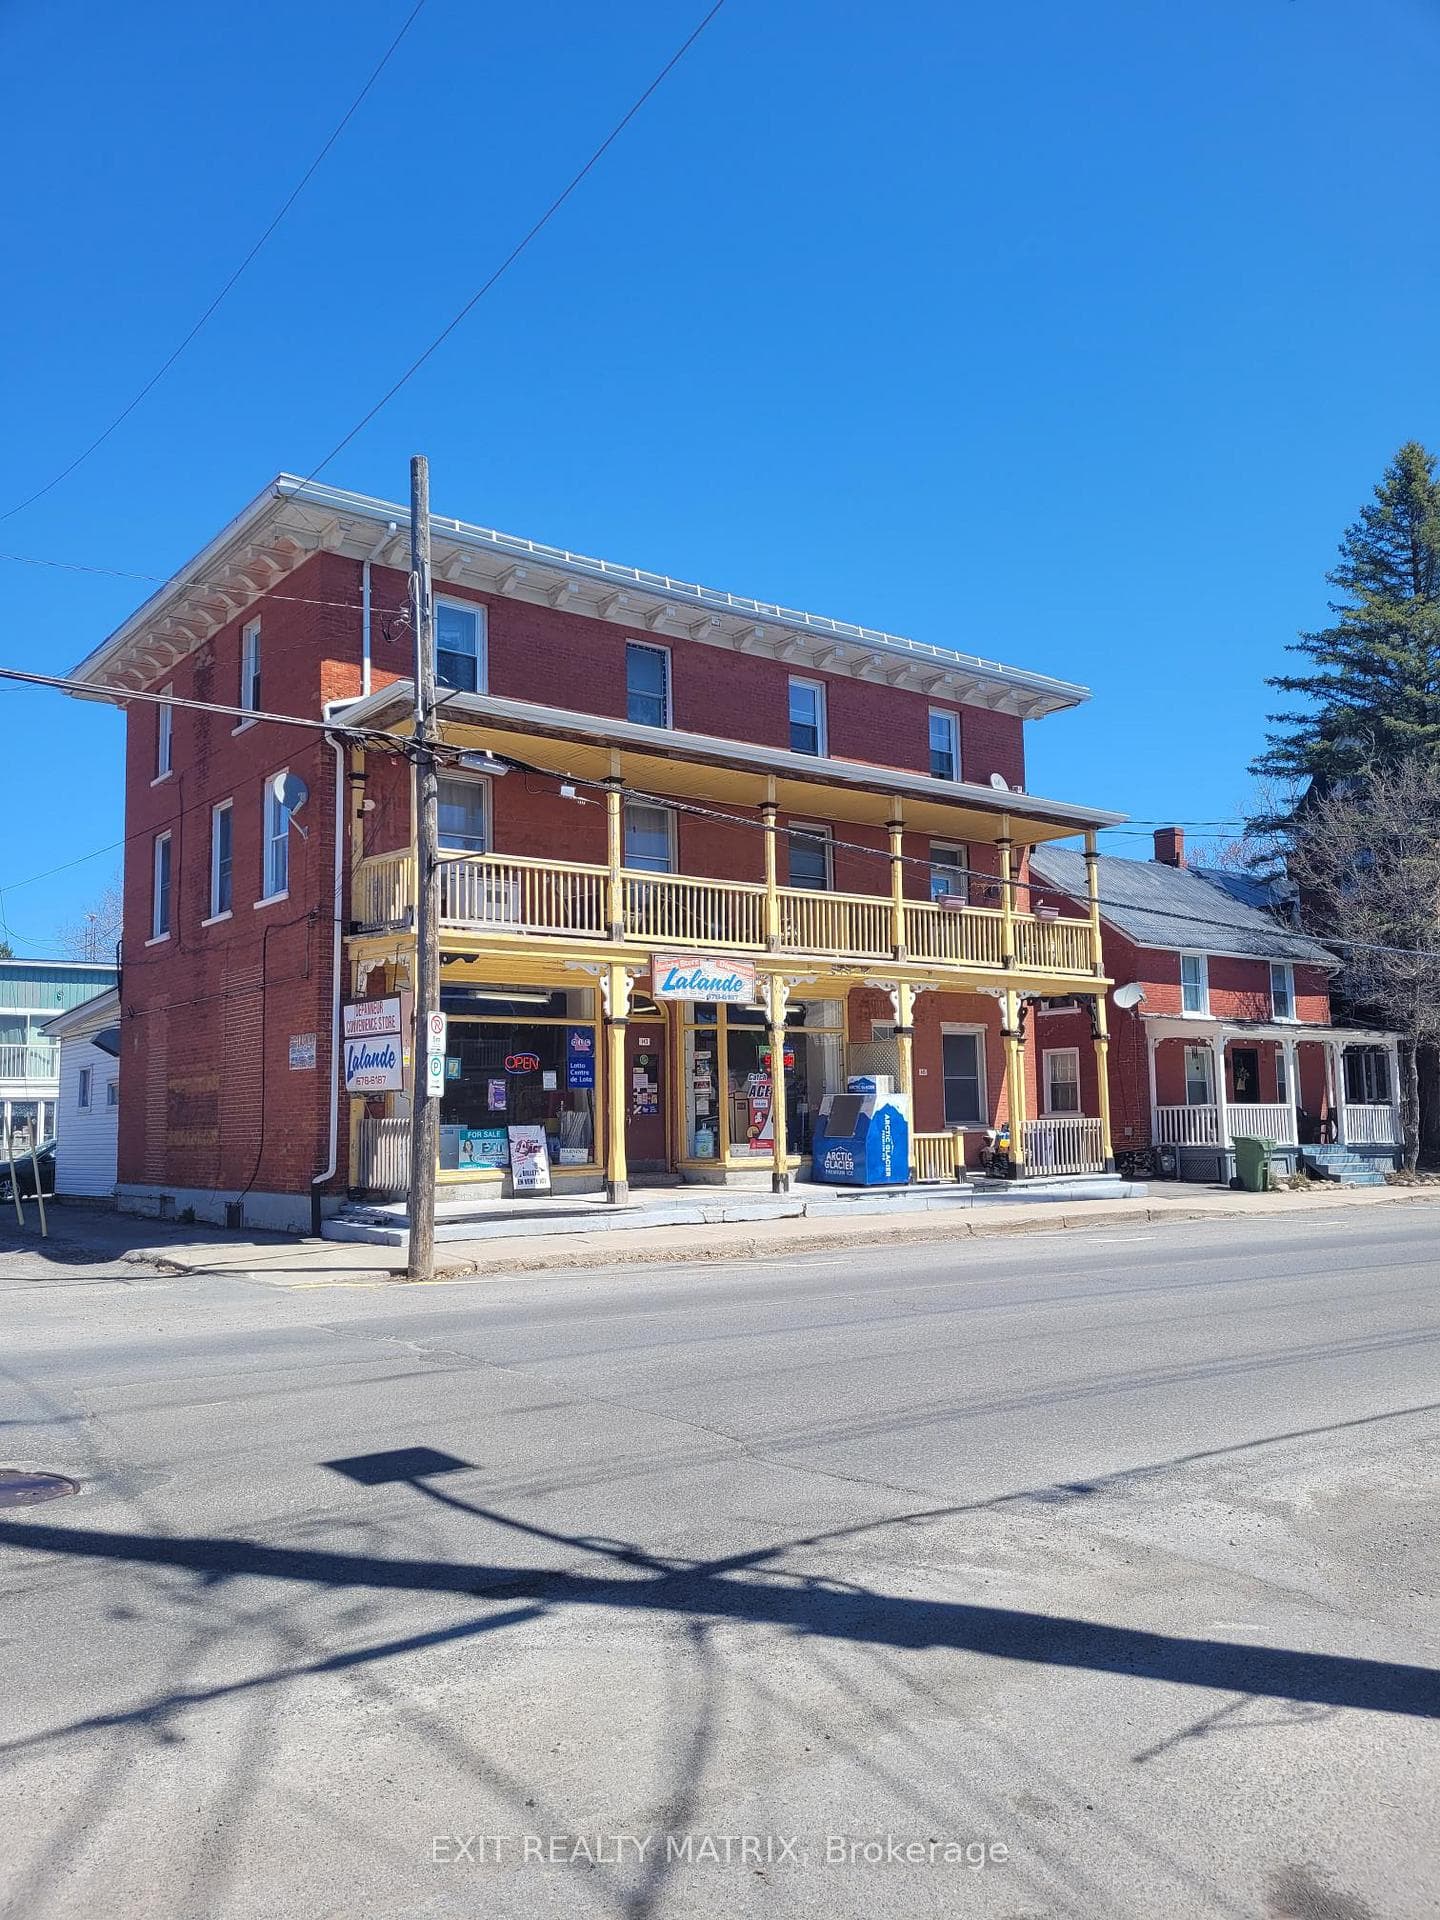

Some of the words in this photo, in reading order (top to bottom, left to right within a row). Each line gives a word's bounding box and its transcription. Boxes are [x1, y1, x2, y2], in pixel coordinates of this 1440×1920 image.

[662, 967, 743, 992] Lalande
[346, 1017, 378, 1034] CONVENIENCE
[379, 1015, 396, 1030] STORE
[347, 1043, 396, 1082] Lalande
[504, 1055, 539, 1071] OPEN
[748, 1073, 767, 1081] Catch
[748, 1084, 771, 1098] ACE
[467, 1131, 482, 1139] FOR
[483, 1130, 501, 1138] SALE
[826, 1151, 853, 1161] ARCTIC
[824, 1161, 854, 1170] GLACIER
